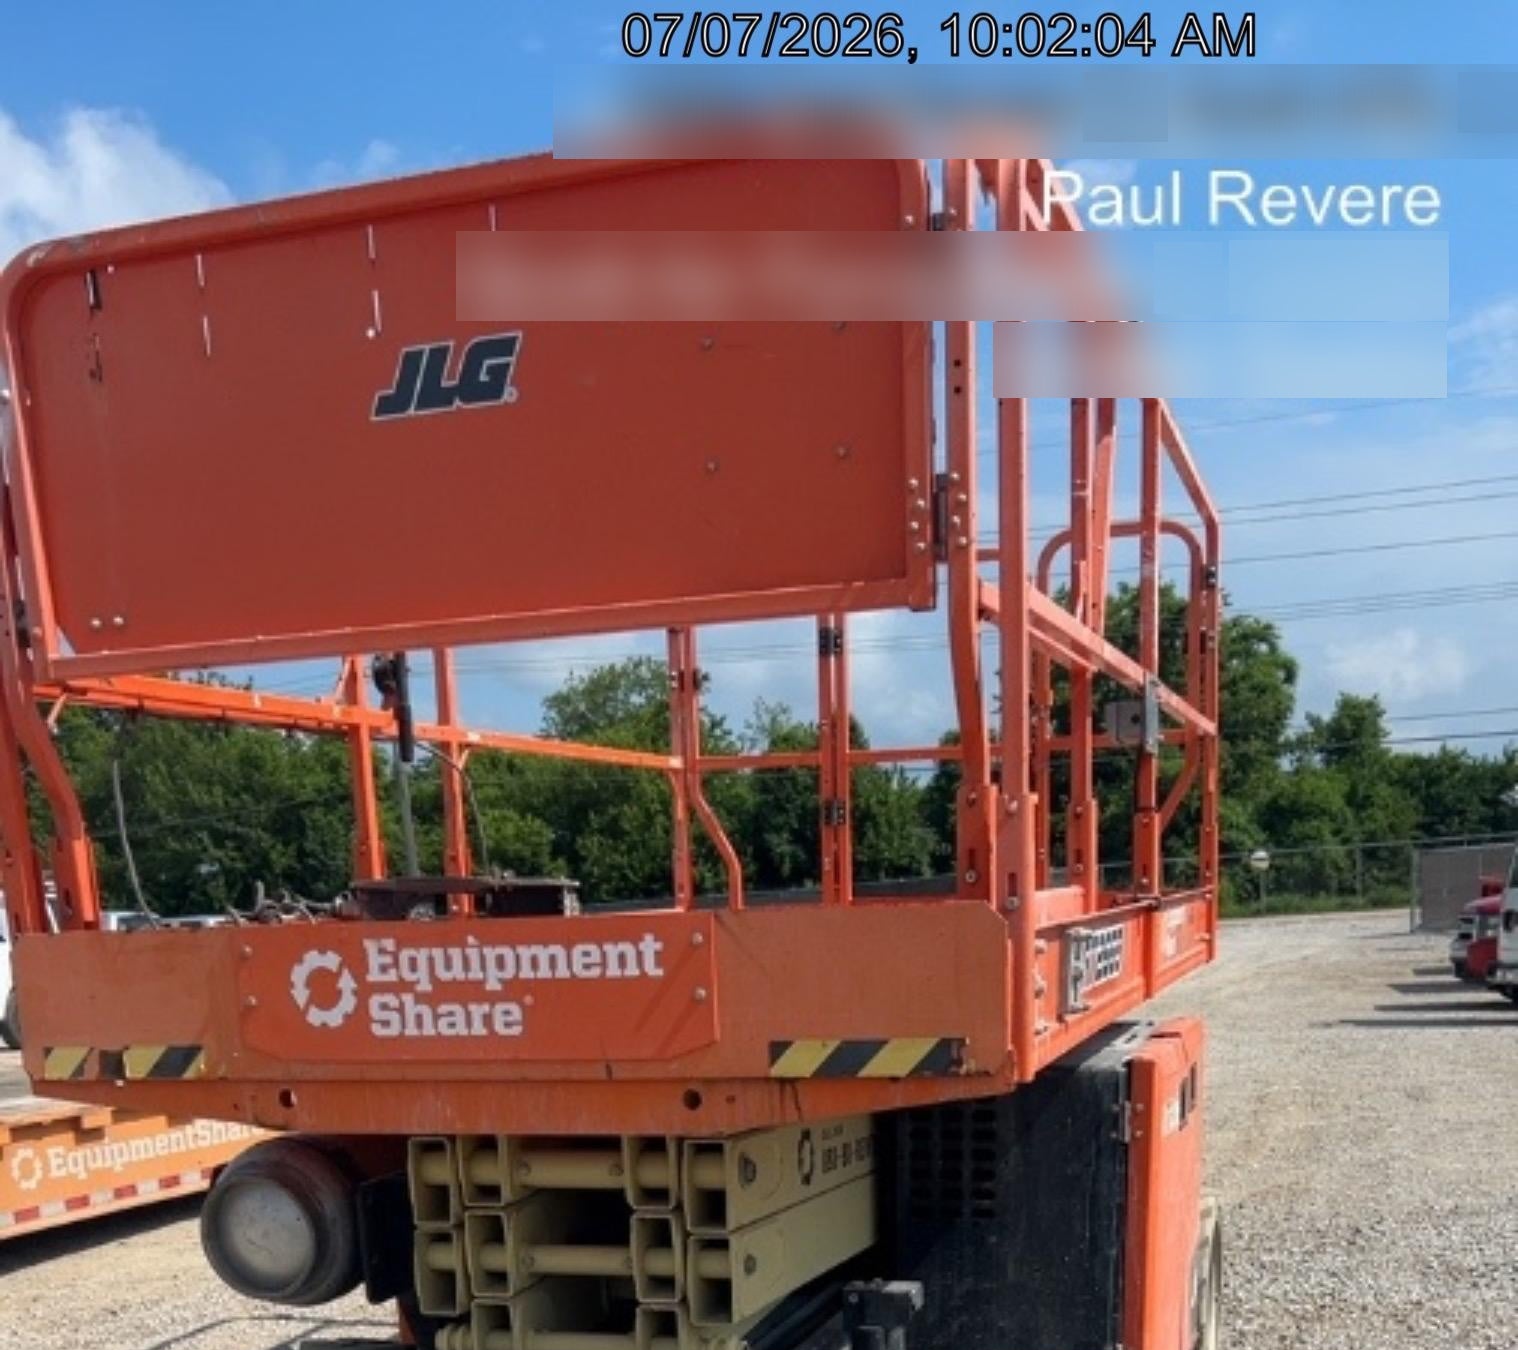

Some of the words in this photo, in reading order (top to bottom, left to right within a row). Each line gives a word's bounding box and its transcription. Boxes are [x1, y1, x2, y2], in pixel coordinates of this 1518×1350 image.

[371, 330, 522, 421] JLG
[362, 932, 664, 991] Equipment
[368, 992, 523, 1038] Share
